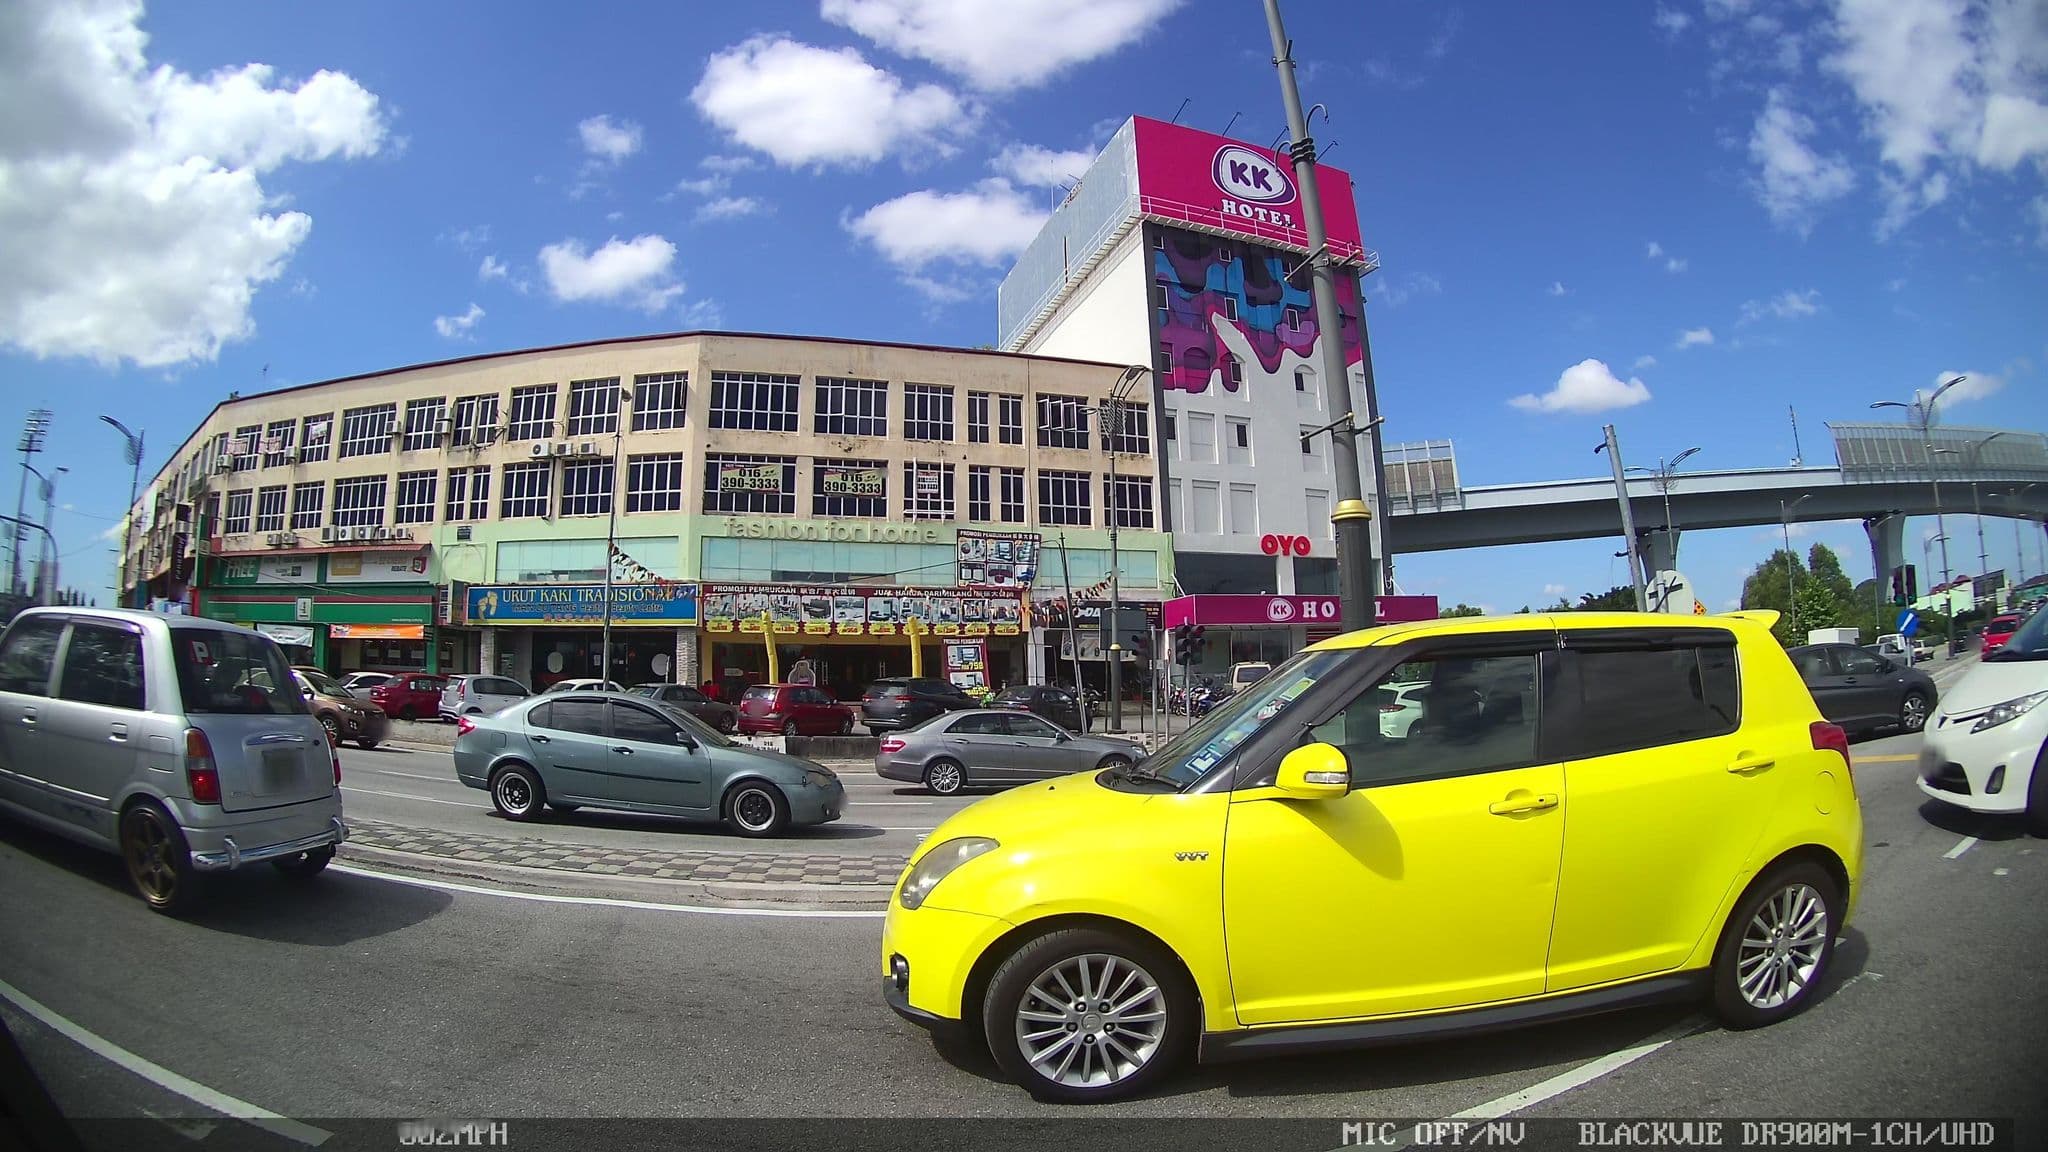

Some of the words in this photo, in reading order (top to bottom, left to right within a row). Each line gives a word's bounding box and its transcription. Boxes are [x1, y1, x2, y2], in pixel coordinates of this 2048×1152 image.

[1229, 159, 1273, 192] KK
[1221, 198, 1296, 229] HOTEL
[739, 468, 761, 478] 016
[841, 473, 863, 482] 016
[722, 477, 779, 489] 390-3333
[824, 481, 880, 493] 390-3333
[724, 517, 818, 539] fashion
[825, 519, 861, 542] for
[867, 521, 937, 544] home
[1260, 533, 1312, 557] OYO
[503, 589, 536, 602] URUT
[540, 589, 571, 602] KAKI
[712, 585, 747, 593] PROMOSI
[748, 586, 796, 594] PEMBUKAAN
[924, 590, 941, 598] DARI
[1273, 604, 1288, 615] KK
[1302, 601, 1386, 618] HOL
[192, 641, 209, 663] P
[1174, 851, 1209, 862] VVT
